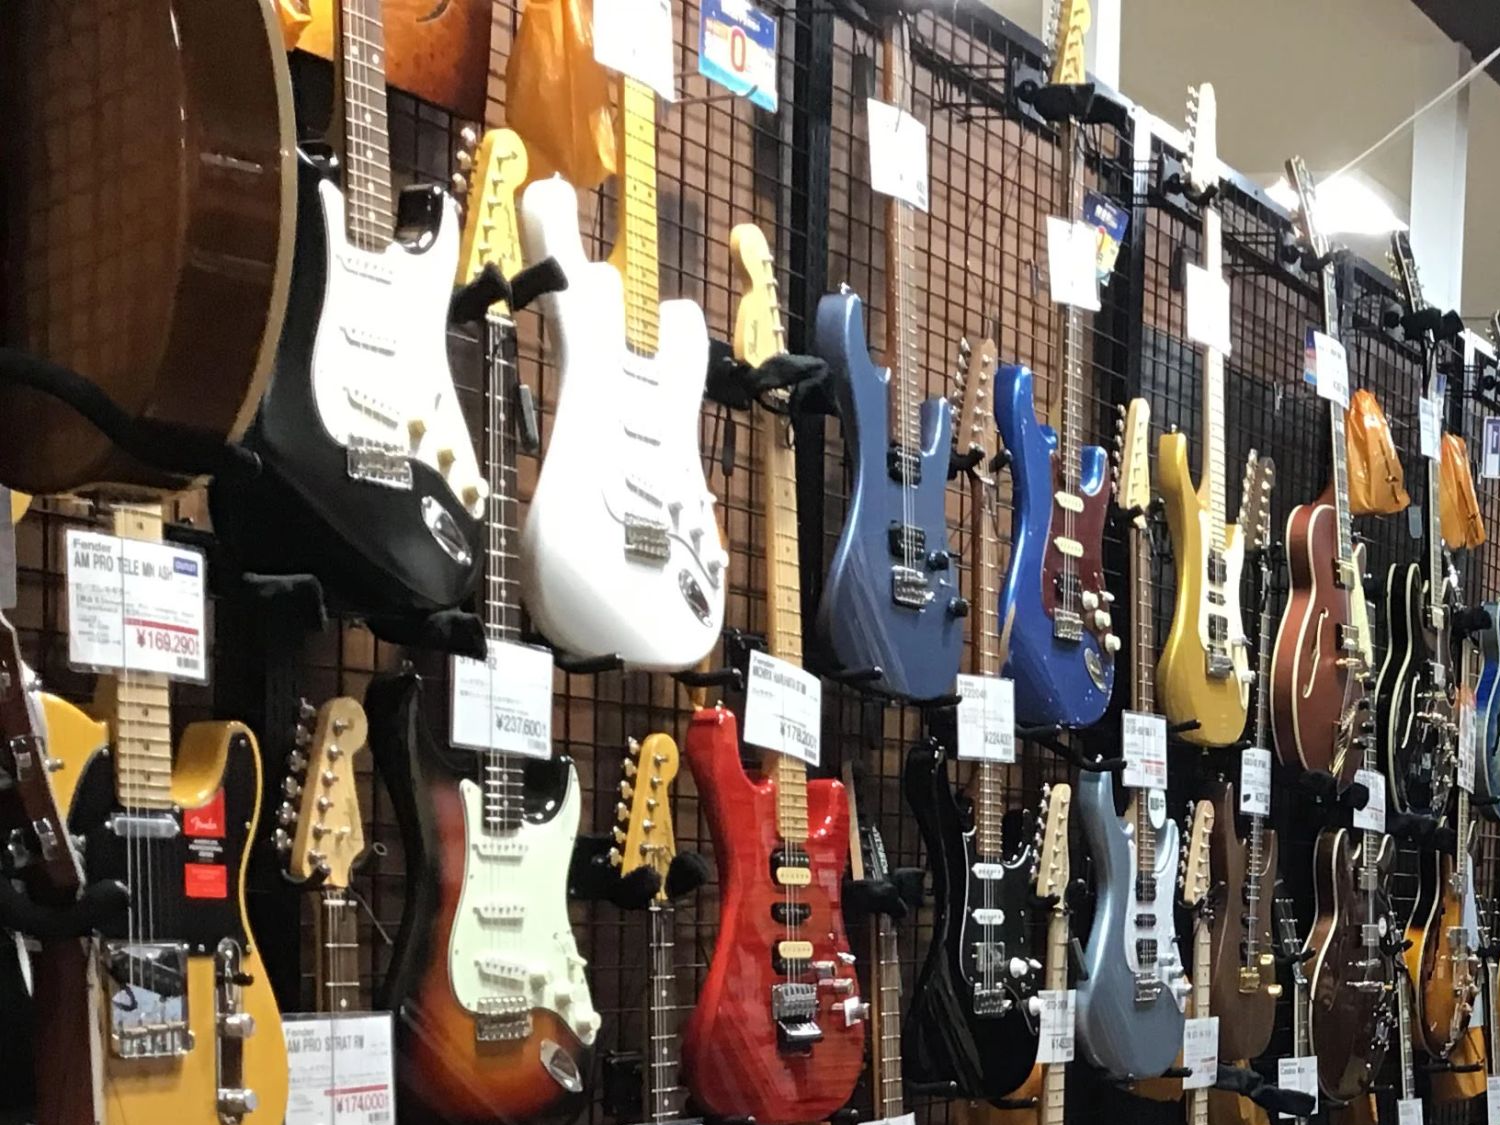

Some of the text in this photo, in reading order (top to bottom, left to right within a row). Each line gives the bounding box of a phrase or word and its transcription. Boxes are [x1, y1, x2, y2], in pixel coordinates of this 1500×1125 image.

[73, 537, 112, 553] Fender
[73, 552, 90, 569] AM
[93, 554, 114, 573] PRO
[117, 557, 139, 577] TELE
[287, 1038, 300, 1053] AM
[303, 1037, 321, 1052] PRO
[325, 1035, 351, 1051] STRAT
